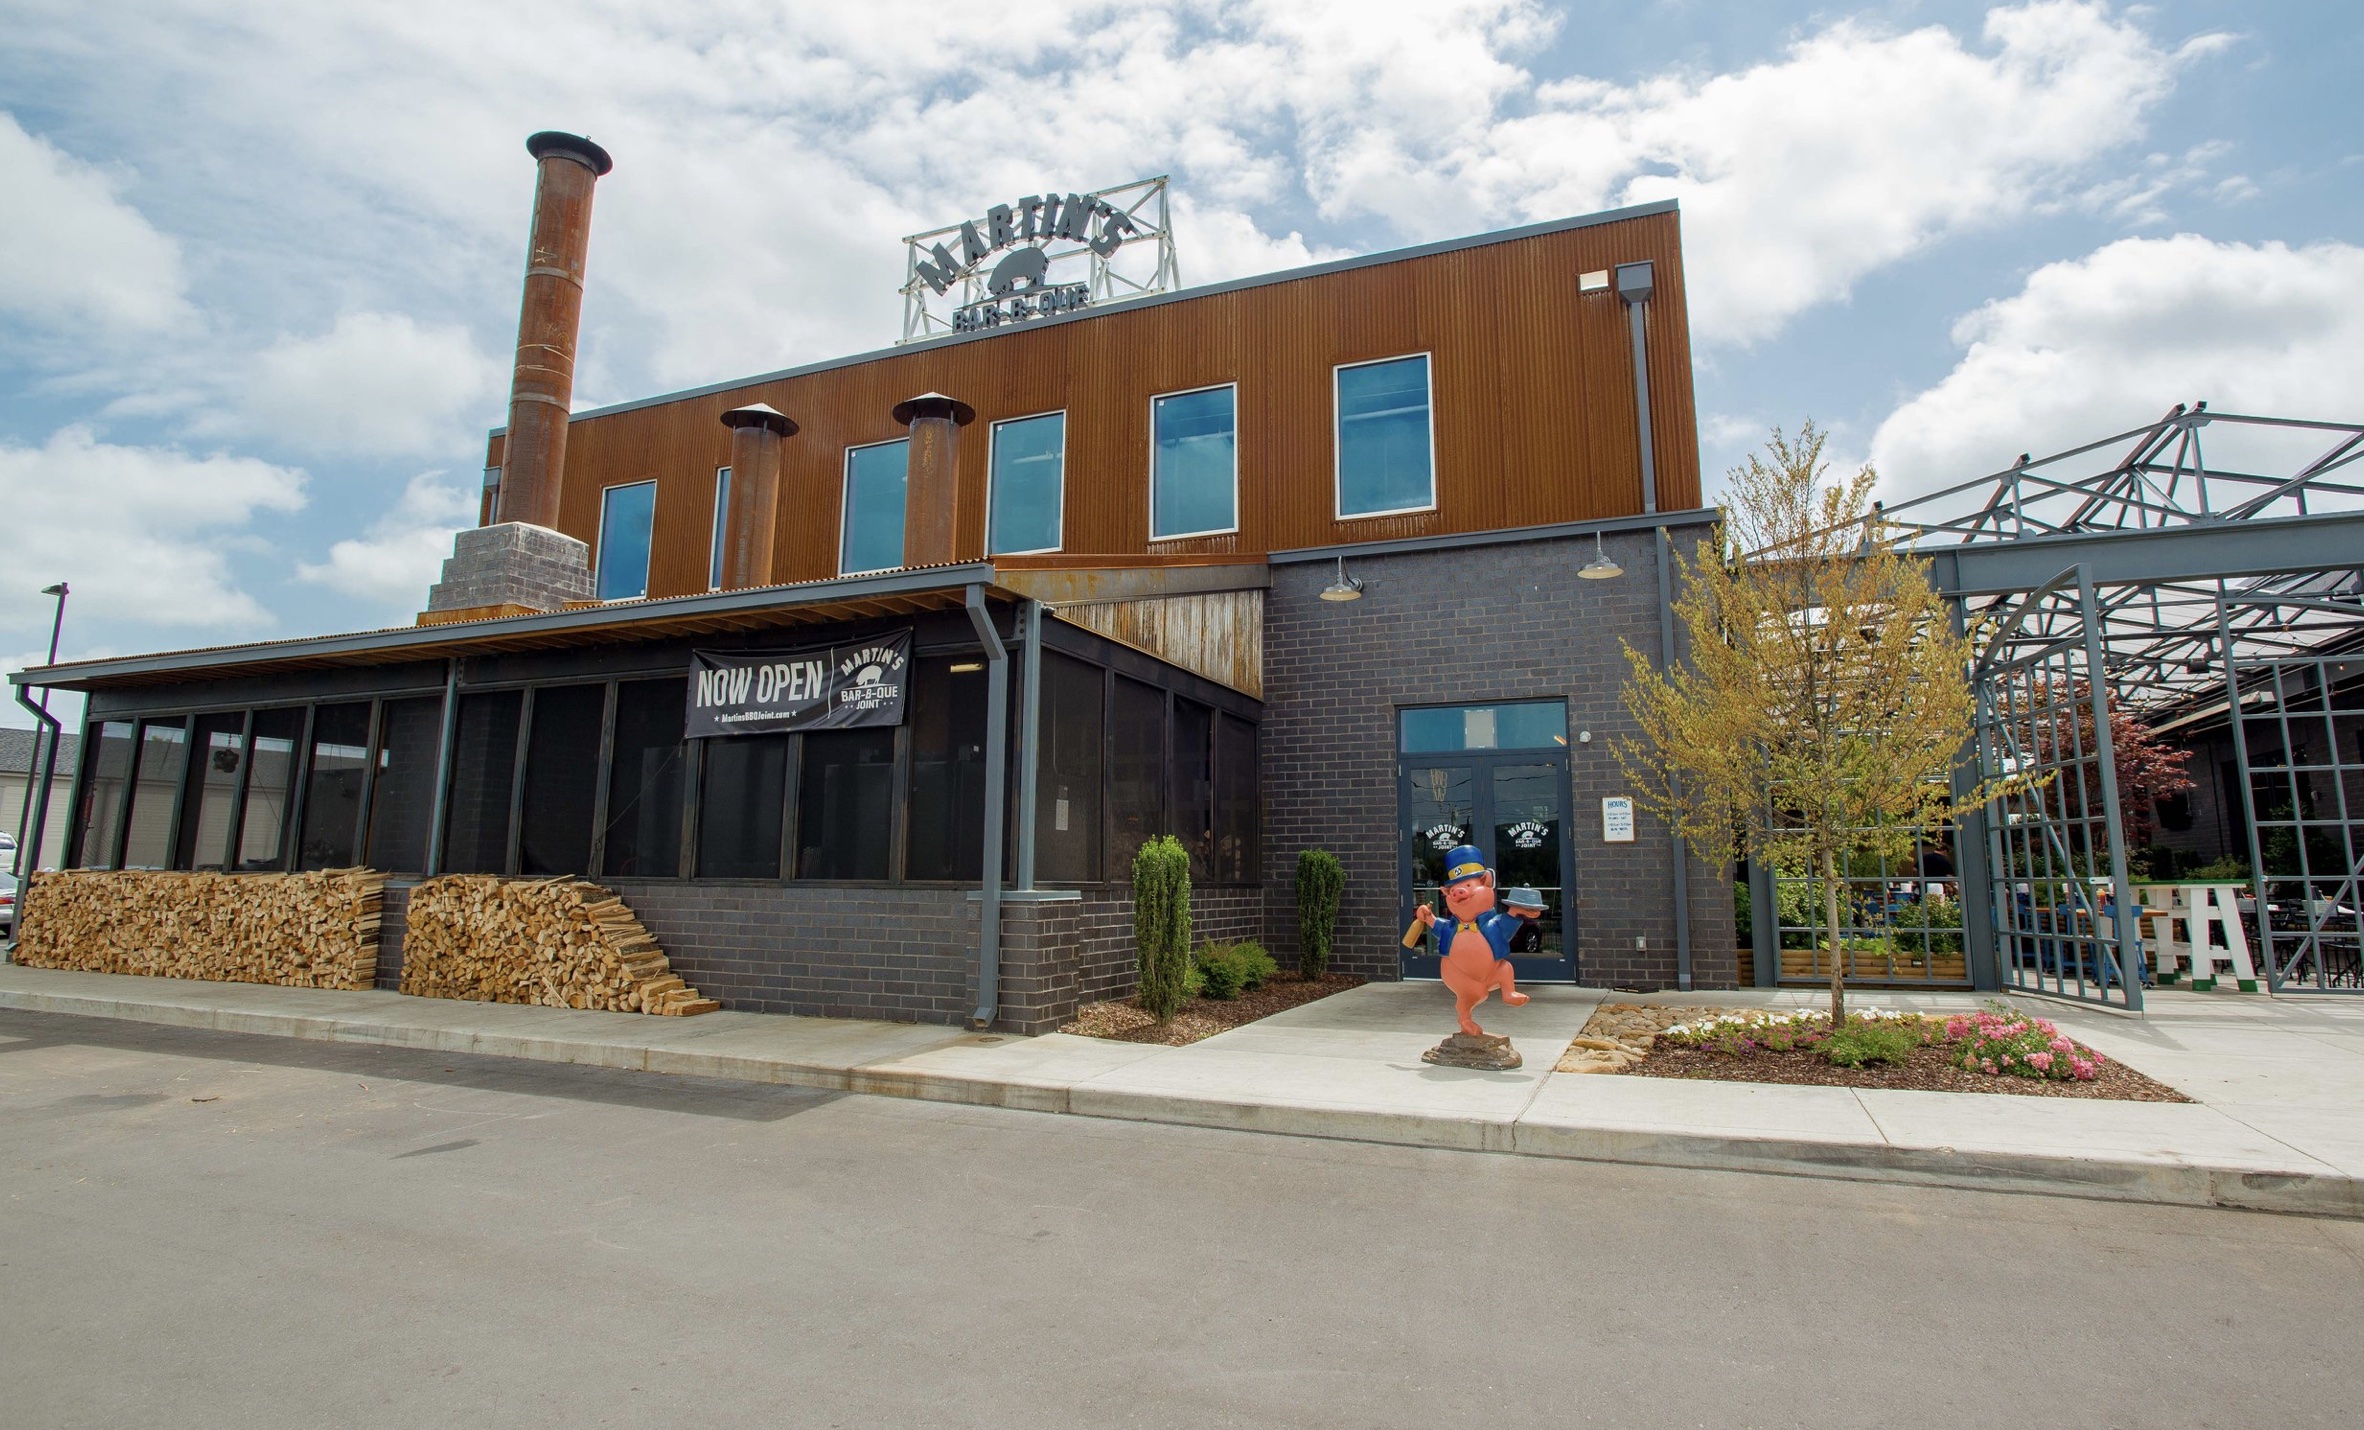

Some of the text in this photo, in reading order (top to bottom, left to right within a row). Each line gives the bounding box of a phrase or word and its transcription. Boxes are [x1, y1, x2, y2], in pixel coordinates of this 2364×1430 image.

[915, 193, 1137, 297] MARTIN'S
[952, 284, 1089, 334] BAR-B-QUE
[840, 647, 905, 677] MARTIN'S
[696, 660, 824, 708] NOW OPEN
[840, 685, 898, 703] BAR-B-QUE
[856, 699, 880, 710] JOINT
[721, 710, 790, 723] MartinsBBQJoint.com
[1607, 800, 1628, 809] HOURS
[1425, 823, 1466, 839] MARTIN'S
[1507, 821, 1549, 837] MARTIN'S
